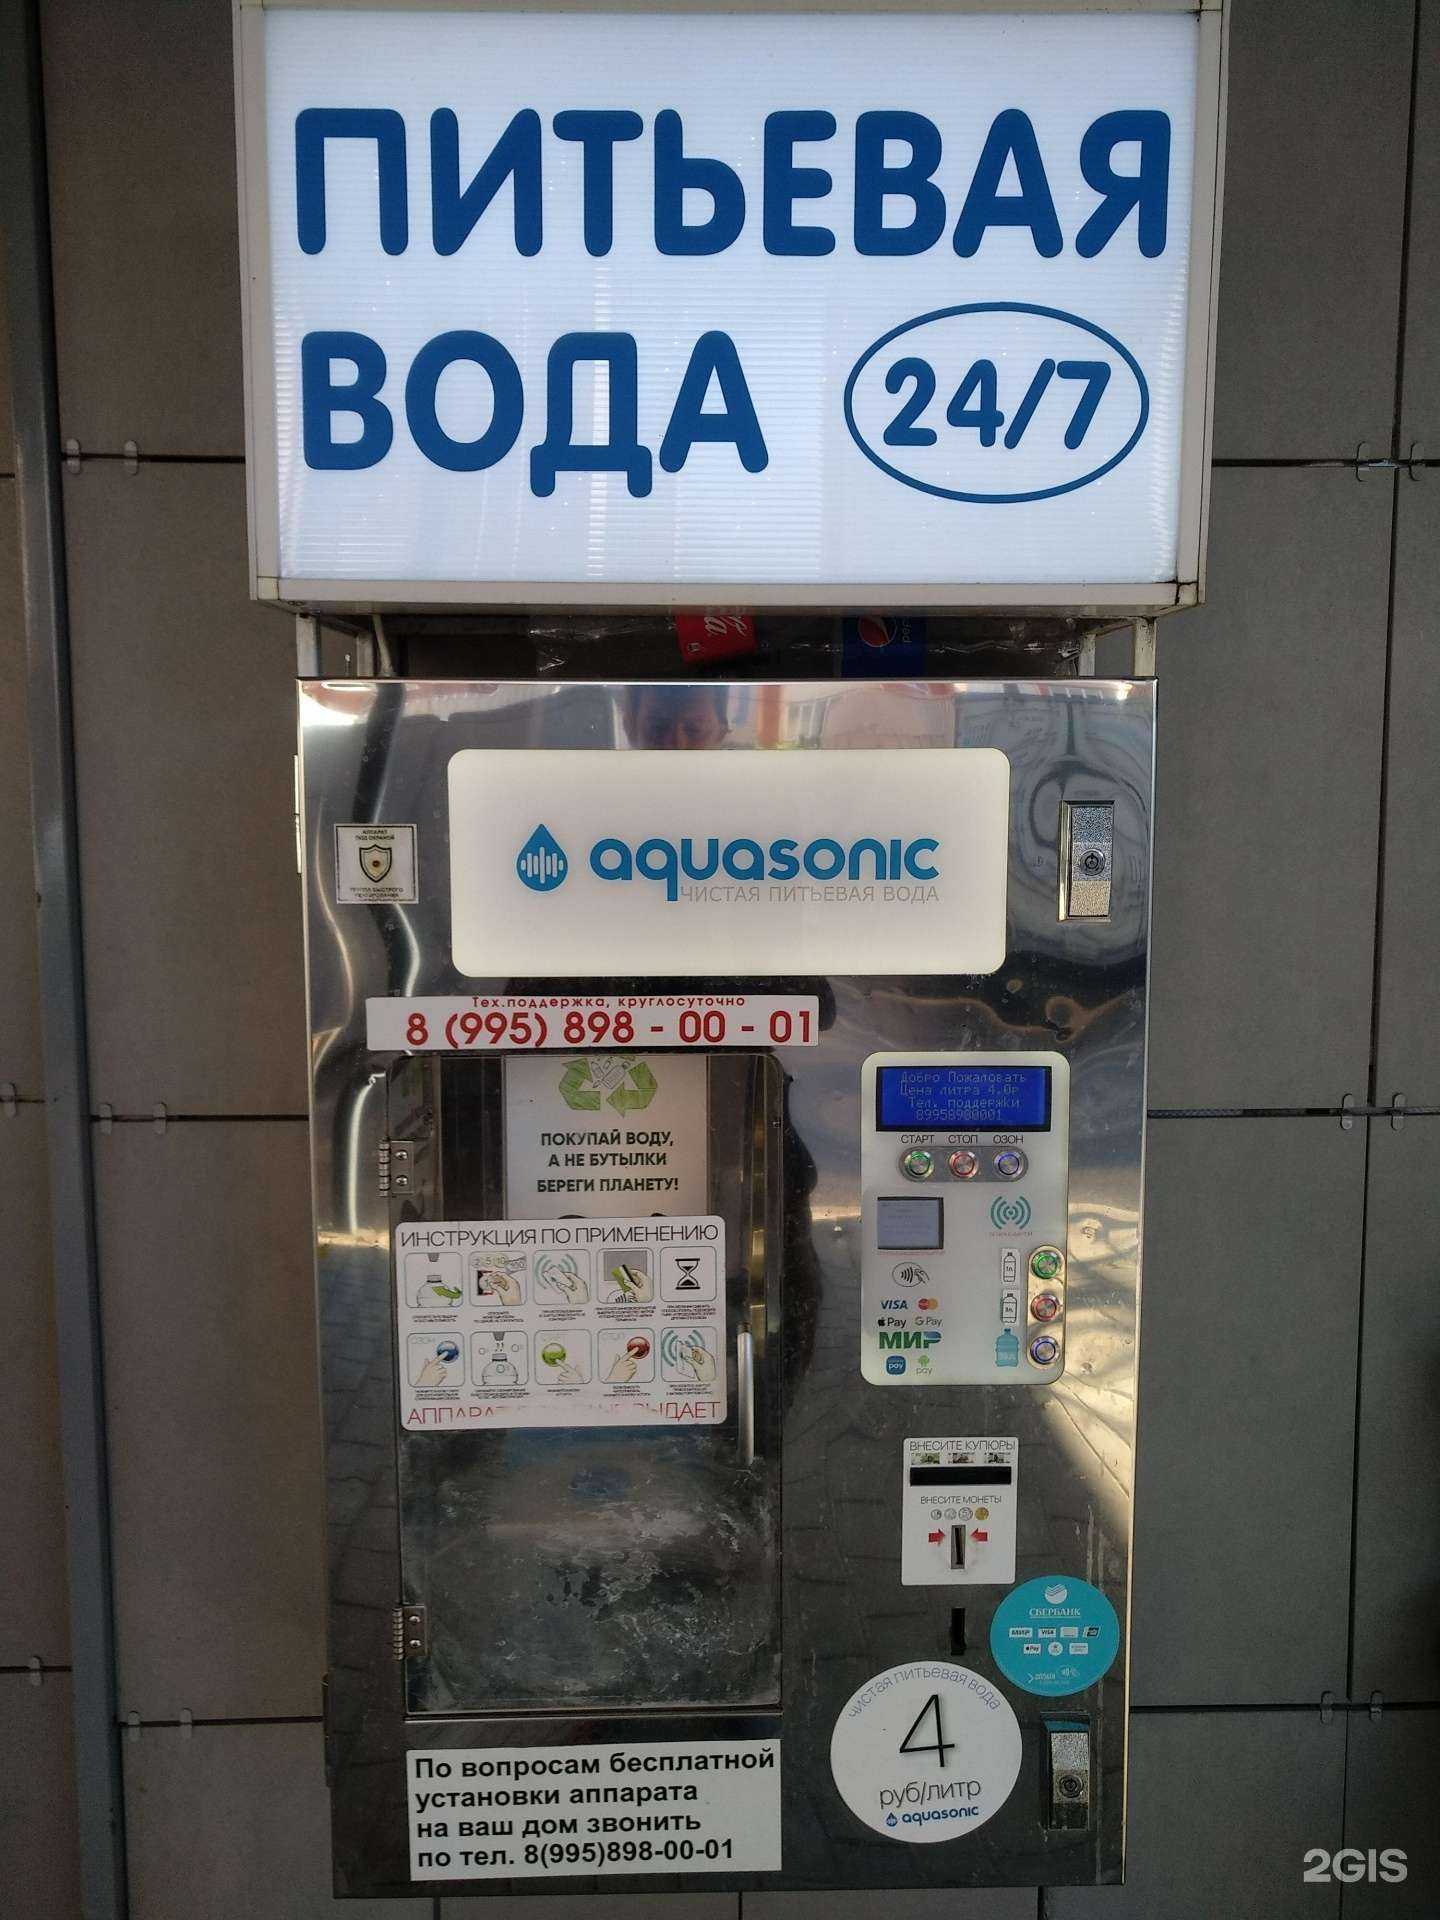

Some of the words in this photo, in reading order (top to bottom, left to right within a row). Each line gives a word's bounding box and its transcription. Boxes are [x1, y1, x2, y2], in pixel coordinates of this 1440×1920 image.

[295, 107, 1172, 258] ПИТЬЕВАЯ
[301, 330, 769, 497] ВОДА
[883, 357, 1111, 450] 24/7
[590, 839, 940, 901] aquasonic
[680, 886, 760, 902] ЧИСТАЯ
[769, 886, 874, 903] ПИТЬЕВАЯ
[884, 886, 940, 904] ВОДА
[472, 997, 610, 1009] Тех.поддержка,
[619, 997, 745, 1009] круглосуточно
[406, 1013, 429, 1045] 8
[445, 1013, 547, 1048] (995)
[563, 1011, 635, 1044] 898
[679, 1010, 726, 1043] 00
[769, 1011, 811, 1043] 01
[541, 1129, 621, 1146] ПОКУПАЙ
[626, 1131, 674, 1147] ВОДУ,
[901, 1135, 935, 1144] СТАРТ
[948, 1135, 978, 1144] СТОП
[993, 1135, 1024, 1144] ОЗОН
[548, 1154, 560, 1167] А
[565, 1154, 585, 1167] НЕ
[590, 1153, 667, 1167] БУТЫЛКИ
[537, 1178, 595, 1193] БЕРЕГИ
[600, 1178, 679, 1192] ПЛАНЕТУ!
[401, 1229, 536, 1248] ИНСТРУКЦИЯ
[542, 1227, 571, 1245] ПО
[576, 1224, 718, 1244] ПРИМЕНЕНИЮ
[881, 1300, 908, 1310] VISA
[887, 1317, 907, 1329] Pay
[926, 1316, 944, 1328] Pay
[879, 1331, 942, 1349] МИР
[909, 1440, 962, 1451] ВНЕСИТЕ
[965, 1440, 1016, 1451] КУПЮРЫ
[920, 1496, 961, 1504] ВНЕСИТЕ
[963, 1496, 1002, 1504] МОНЕТЫ
[1029, 1607, 1081, 1616] СБЕРБАНК
[848, 1678, 893, 1718] чистая
[894, 1667, 968, 1685] питьевая
[967, 1679, 1001, 1710] вода
[900, 1694, 955, 1767] 4
[415, 1758, 452, 1778] По
[462, 1758, 600, 1781] вопросам
[610, 1748, 775, 1773] бесплатной
[415, 1788, 560, 1813] установки
[569, 1784, 698, 1808] аппарата
[879, 1780, 981, 1809] руб/литр
[417, 1821, 449, 1838] на
[458, 1819, 513, 1837] ваш
[522, 1817, 578, 1838] дом
[587, 1813, 702, 1833] звонить
[902, 1806, 979, 1826] aquasonic
[418, 1850, 450, 1867] по
[460, 1847, 515, 1866] тел.
[524, 1839, 733, 1868] 8(995)898-00-01
